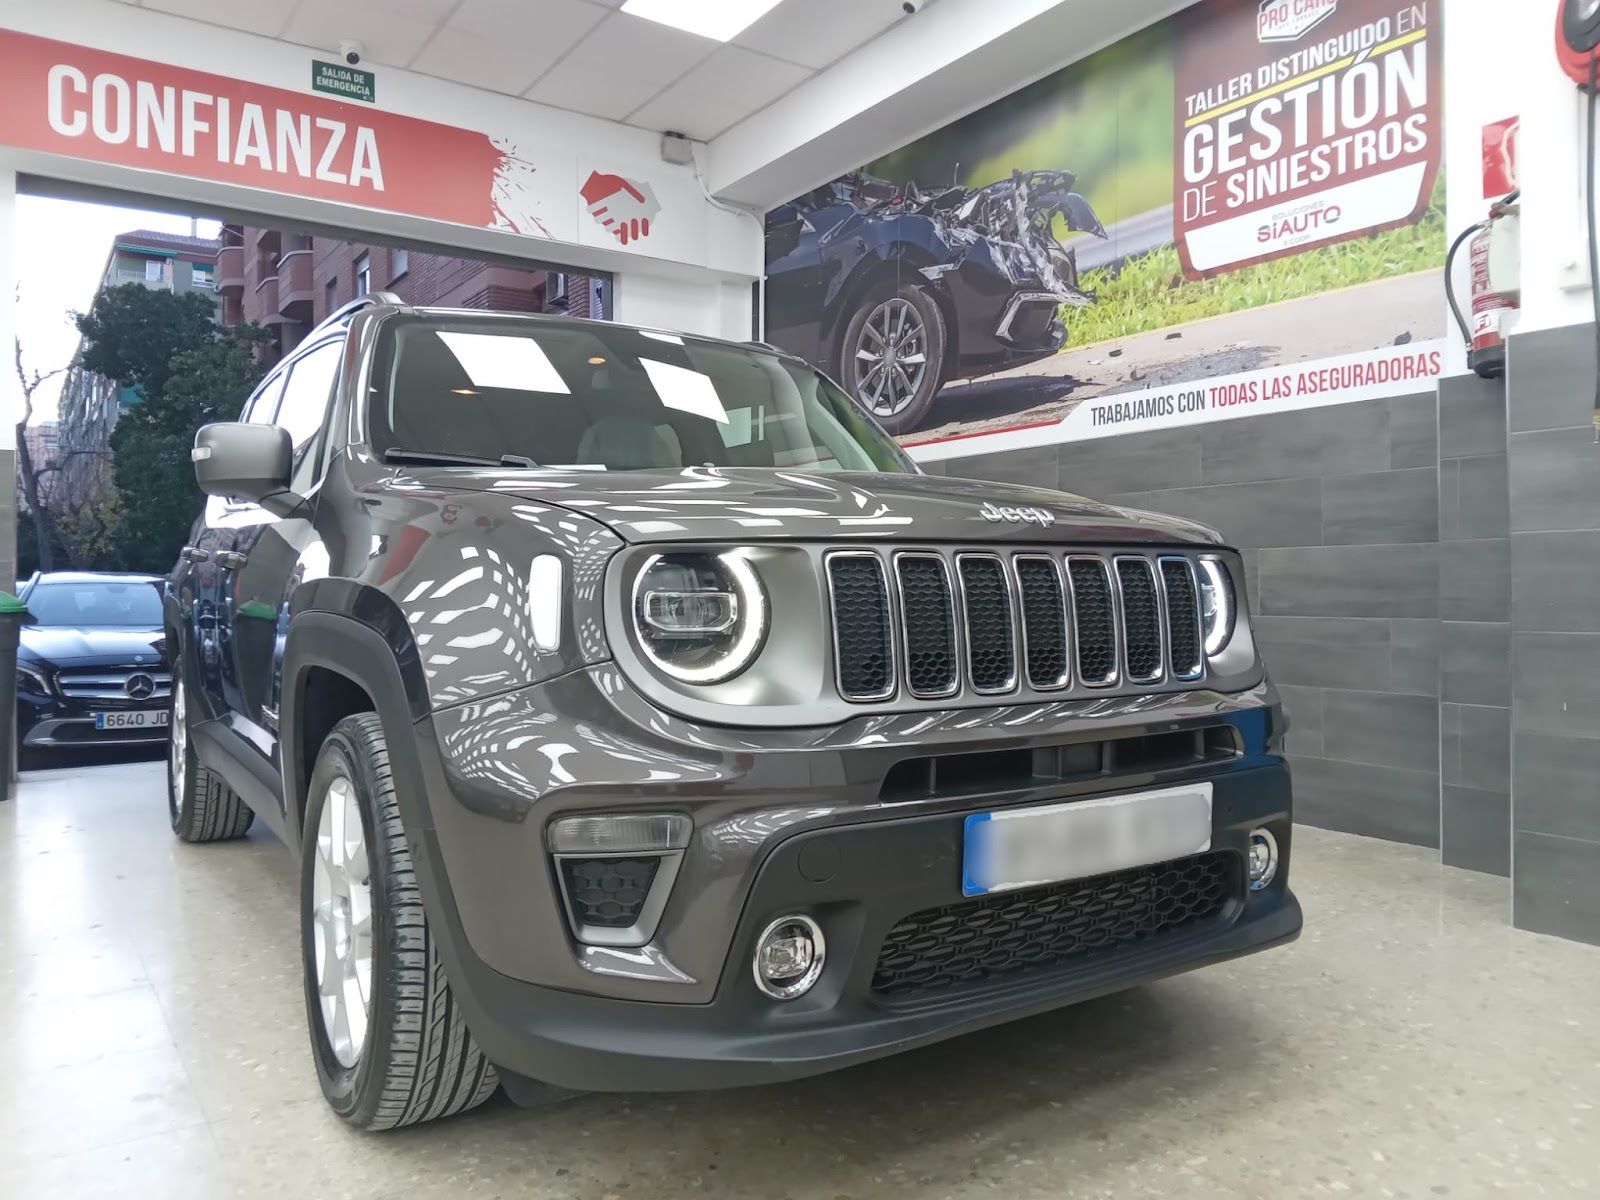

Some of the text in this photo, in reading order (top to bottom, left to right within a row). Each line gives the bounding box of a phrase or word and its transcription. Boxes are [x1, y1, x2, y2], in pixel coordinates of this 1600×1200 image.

[1260, 4, 1288, 35] PRO
[1294, 0, 1336, 16] CA
[316, 76, 371, 96] EMERGENCIA
[321, 66, 365, 84] SALIDA DE
[1185, 72, 1252, 116] TALLER
[1258, 17, 1390, 89] DISTINGUIDO
[1397, 2, 1427, 34] EN
[47, 64, 385, 191] CONFIANZA
[1184, 40, 1427, 183] GESTIÓN
[1183, 113, 1427, 222] DE SINIESTROS
[1091, 351, 1441, 426] TRABAJAMOS CON TODAS LAS ASEGURADORAS
[980, 502, 1055, 528] Jeep
[106, 713, 144, 726] 6640
